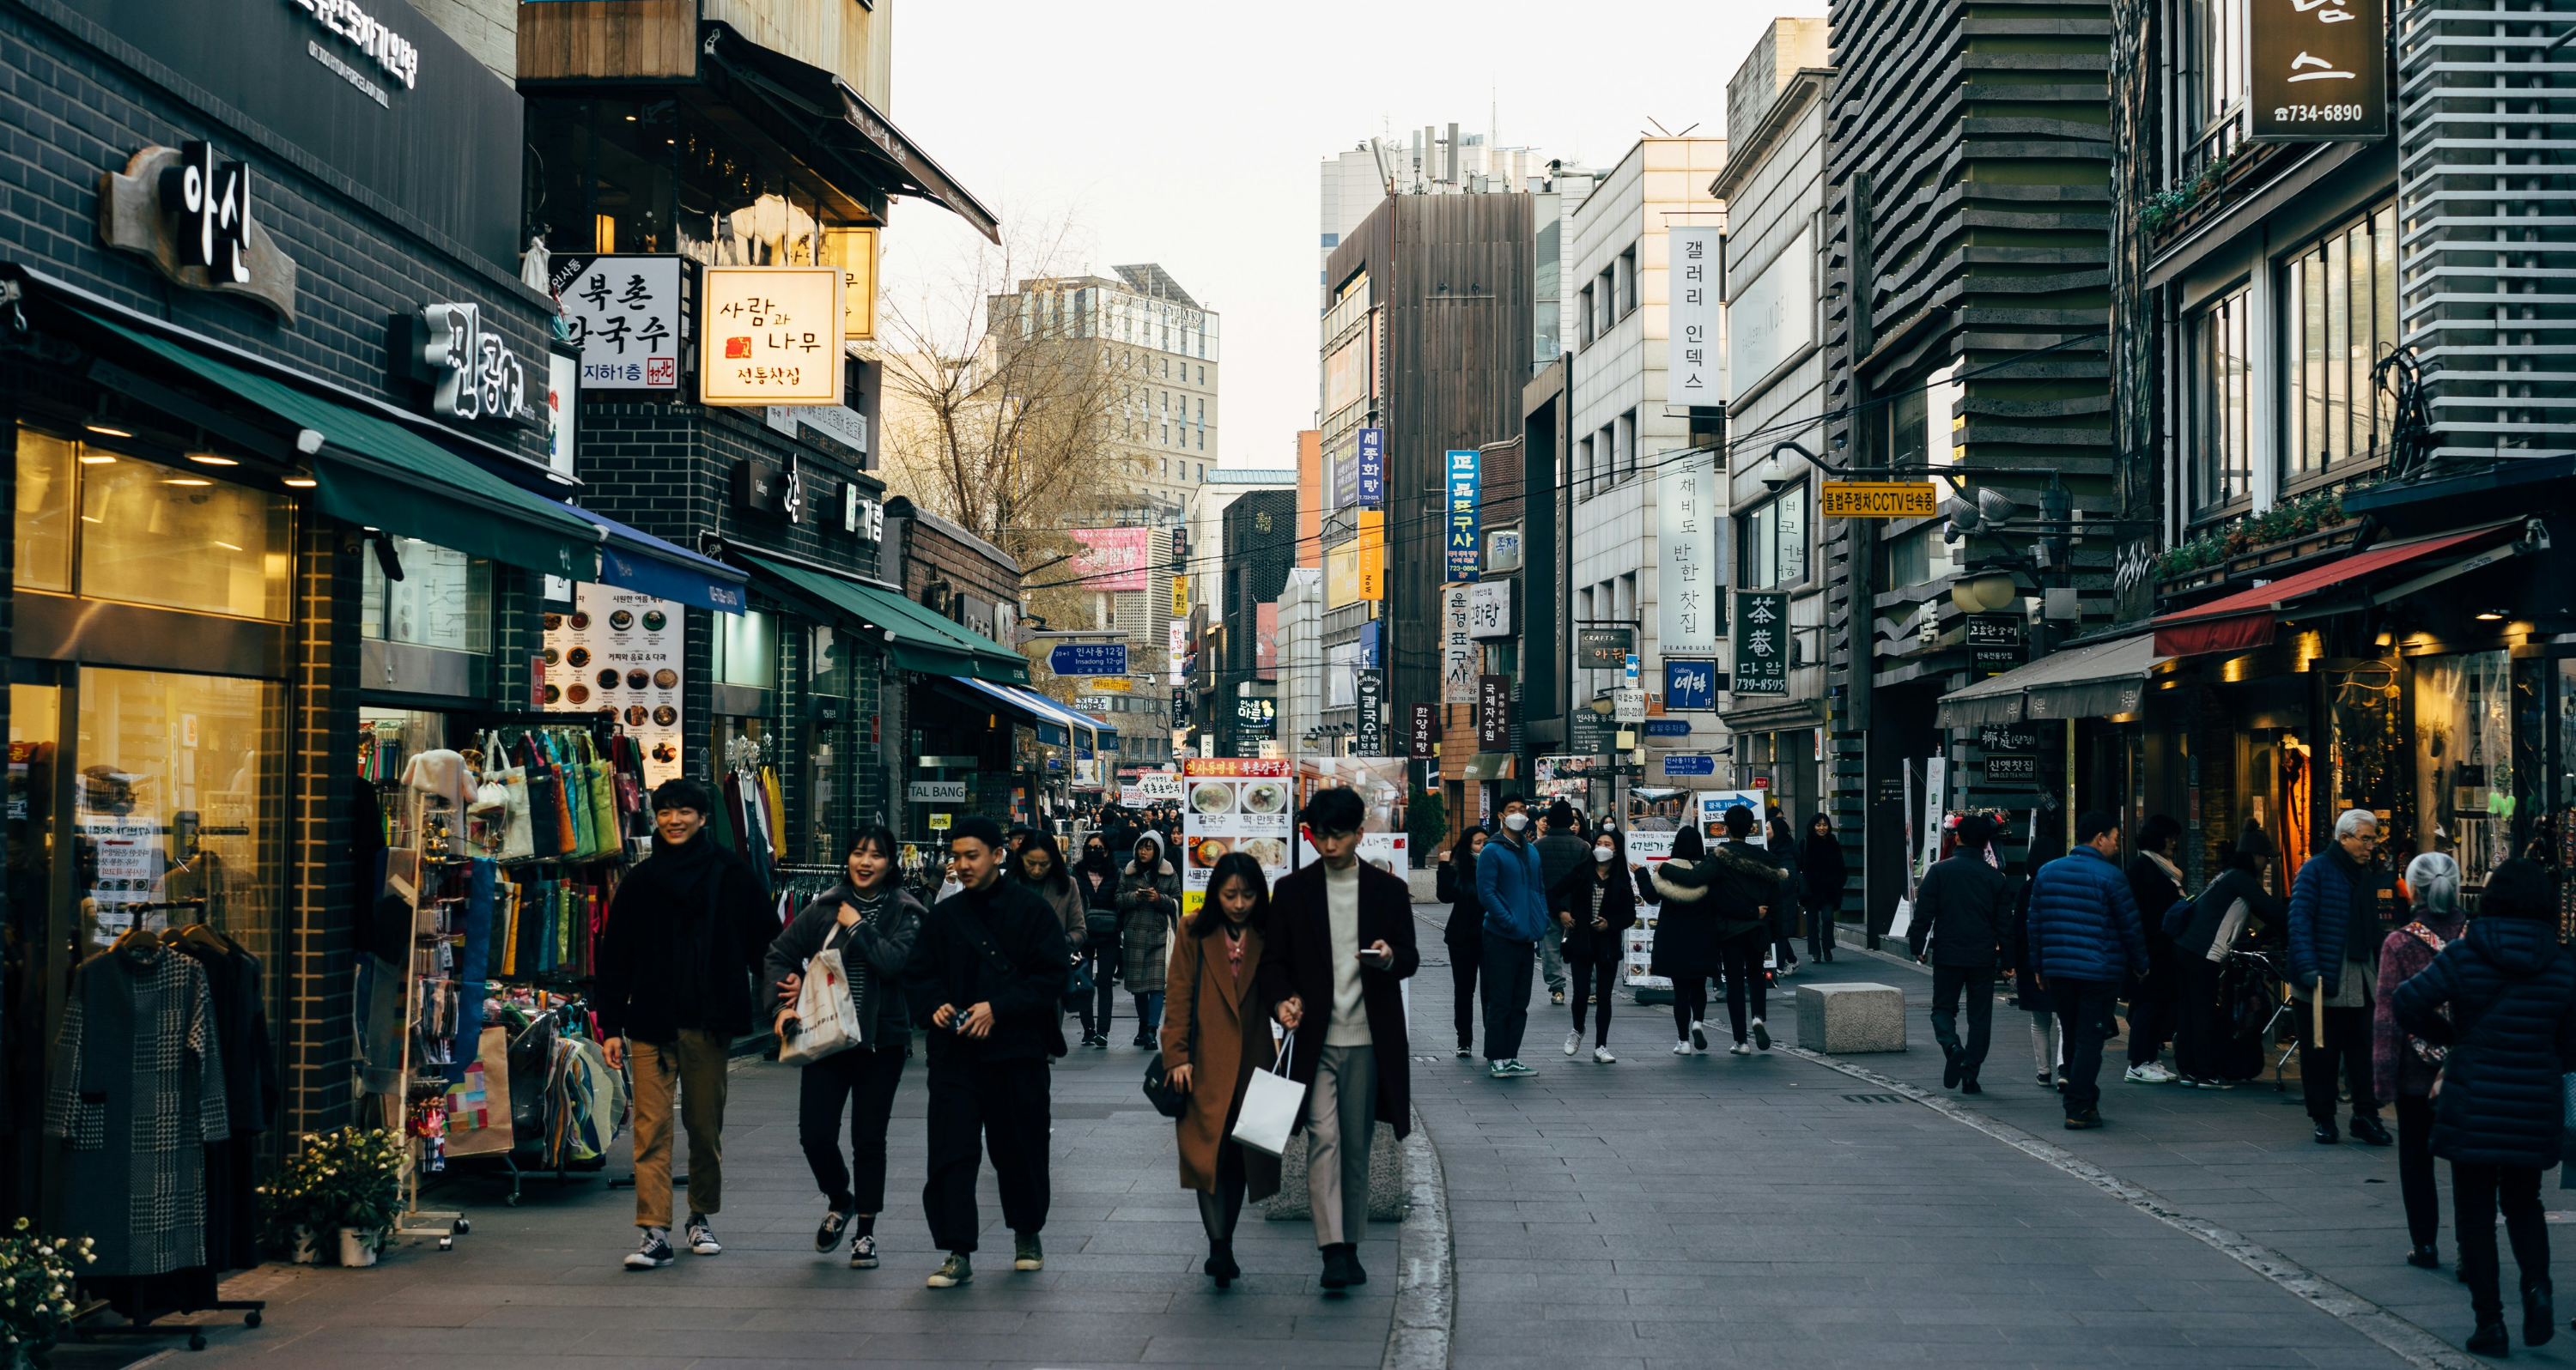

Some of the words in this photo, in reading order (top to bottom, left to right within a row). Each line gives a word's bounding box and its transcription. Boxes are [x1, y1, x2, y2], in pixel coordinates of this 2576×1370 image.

[2288, 104, 2362, 122] 734-6890
[551, 258, 581, 289] 인사동
[1686, 240, 1703, 306] 갤러리
[579, 274, 653, 312] 북촌
[720, 297, 791, 327] 사람과
[568, 316, 671, 355] 칼국수
[769, 332, 822, 353] 나무
[1685, 324, 1704, 388] 인덱스
[584, 364, 642, 381] 지하1층
[738, 367, 799, 385] 전통찻집
[1362, 431, 1380, 493] 세종화랑
[1495, 536, 1518, 558] 족자
[1674, 543, 1699, 582] 반한
[612, 594, 633, 603] 시원한
[1680, 590, 1699, 633] 찻집
[1970, 625, 1996, 636] 고요한
[1998, 627, 2018, 637] 소리
[608, 652, 629, 662] 커피와
[630, 652, 644, 662] 음료
[653, 652, 667, 662] 다과
[1076, 646, 1124, 657] 인사동12길
[1595, 647, 1626, 664] 아원
[1740, 661, 1782, 676] 다암
[1623, 694, 1633, 702] 없는
[1633, 694, 1643, 703] 거리
[1704, 697, 1712, 707] 1F
[1237, 707, 1261, 724] 마루
[1362, 695, 1377, 735] 칼국수
[1485, 684, 1496, 741] 국제자수원
[1576, 713, 1598, 722] 인사동
[1415, 706, 1428, 753] 한양화랑
[1360, 734, 1379, 743] 만두
[1186, 761, 1237, 775] 인사동명물
[1239, 761, 1291, 775] 북촌칼국수
[1989, 760, 2034, 772] 신옛찻집
[910, 785, 930, 797] TAL
[933, 785, 964, 797] BANG
[1198, 815, 1227, 825] 칼국수
[1631, 841, 1664, 852] 47번가
